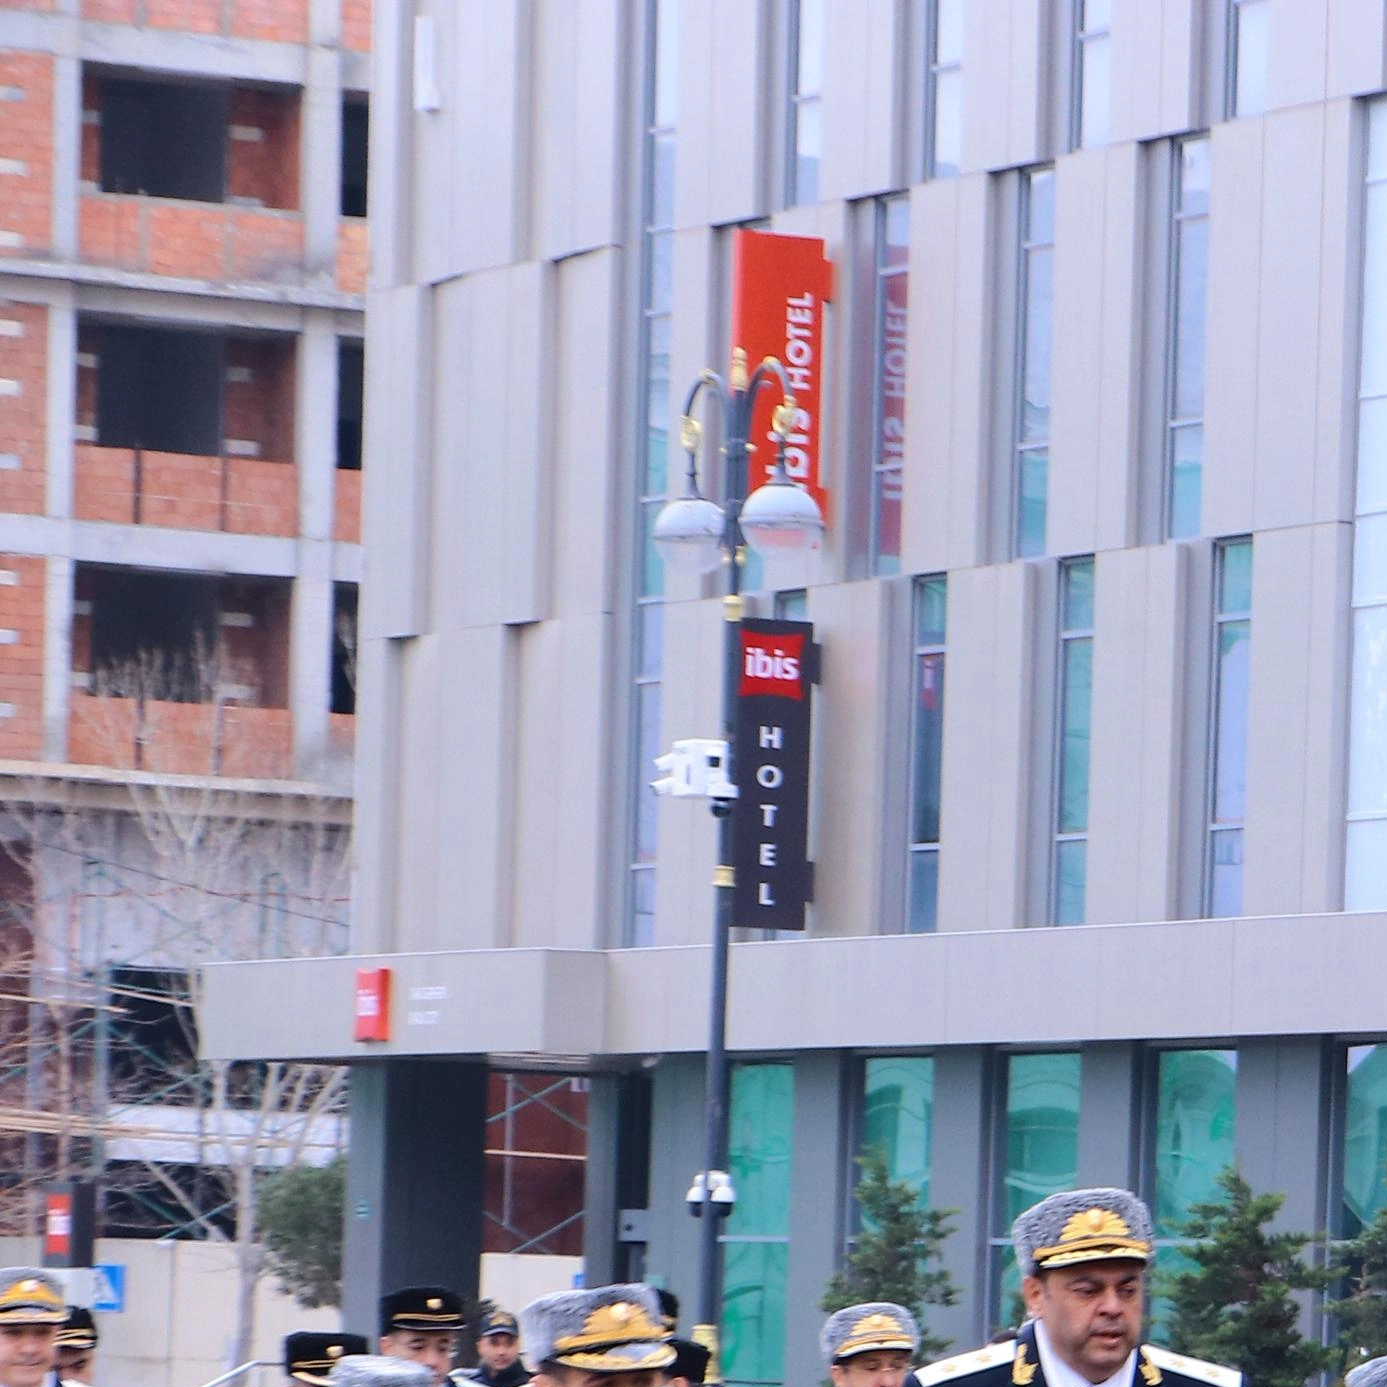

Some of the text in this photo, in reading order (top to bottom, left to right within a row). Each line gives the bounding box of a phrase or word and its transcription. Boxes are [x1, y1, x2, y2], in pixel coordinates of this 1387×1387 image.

[785, 291, 815, 391] HOTEL
[745, 647, 800, 680] ibis
[756, 726, 783, 904] HOTEL
